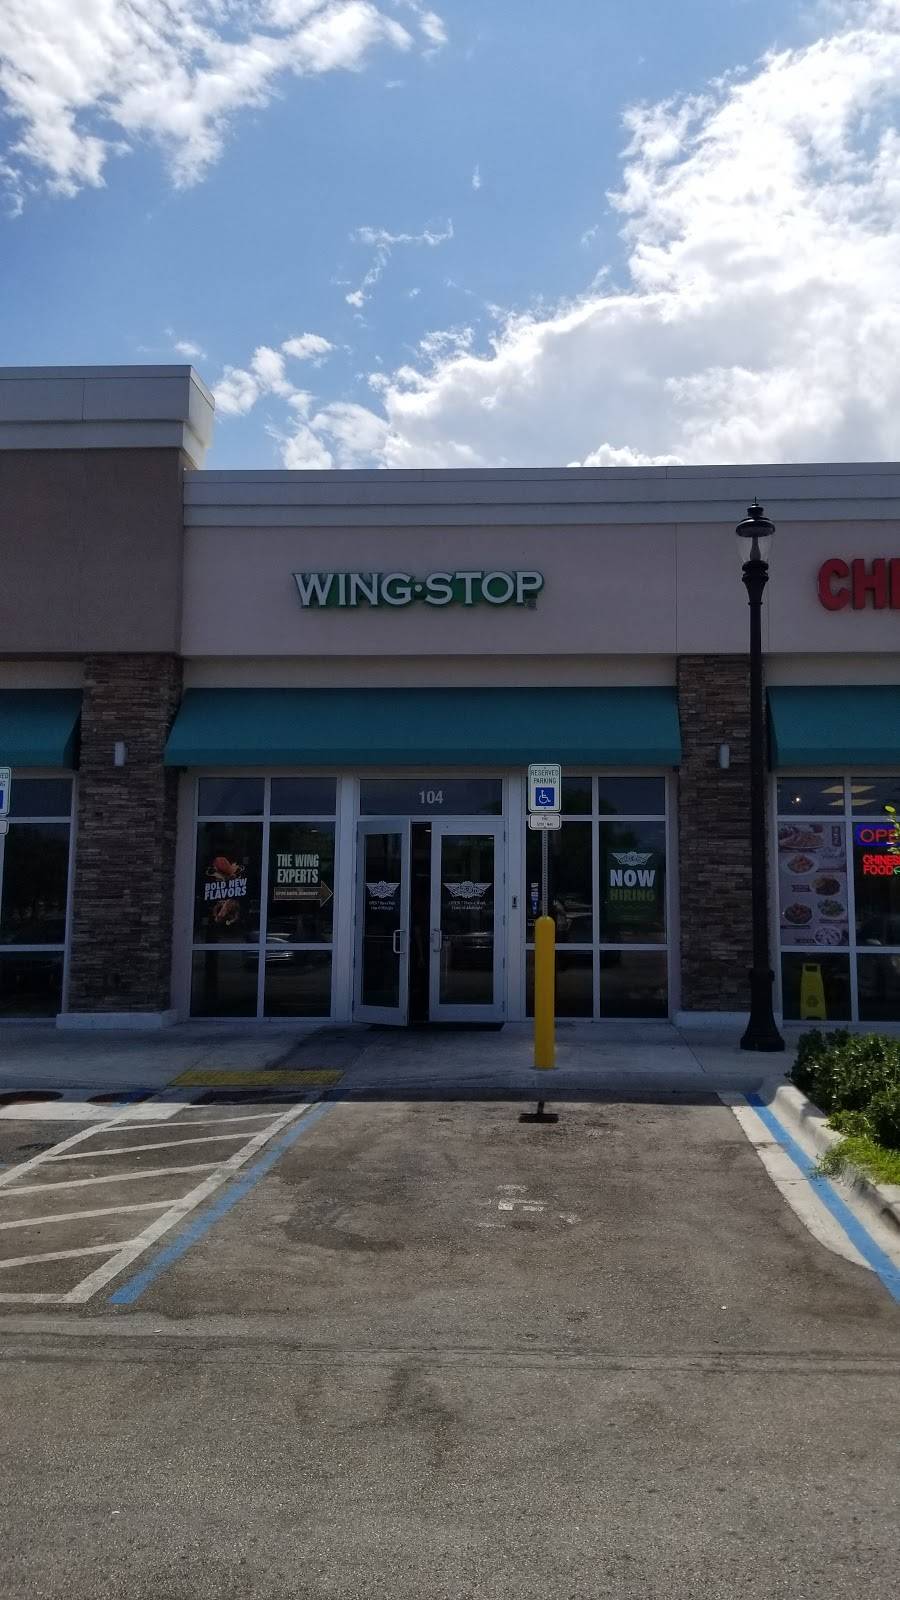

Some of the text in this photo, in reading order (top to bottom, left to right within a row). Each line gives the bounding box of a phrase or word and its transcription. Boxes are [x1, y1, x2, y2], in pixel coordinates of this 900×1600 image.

[531, 769, 560, 777] RESERVED
[533, 777, 557, 785] PARKING
[418, 790, 444, 804] 104
[277, 853, 319, 868] THE WING
[277, 868, 319, 884] EXPERTS
[862, 865, 894, 876] FOOD
[205, 878, 248, 891] BOLD NEW
[610, 869, 656, 888] NOW
[204, 886, 247, 900] FLAVORS
[610, 888, 656, 901] HIRING
